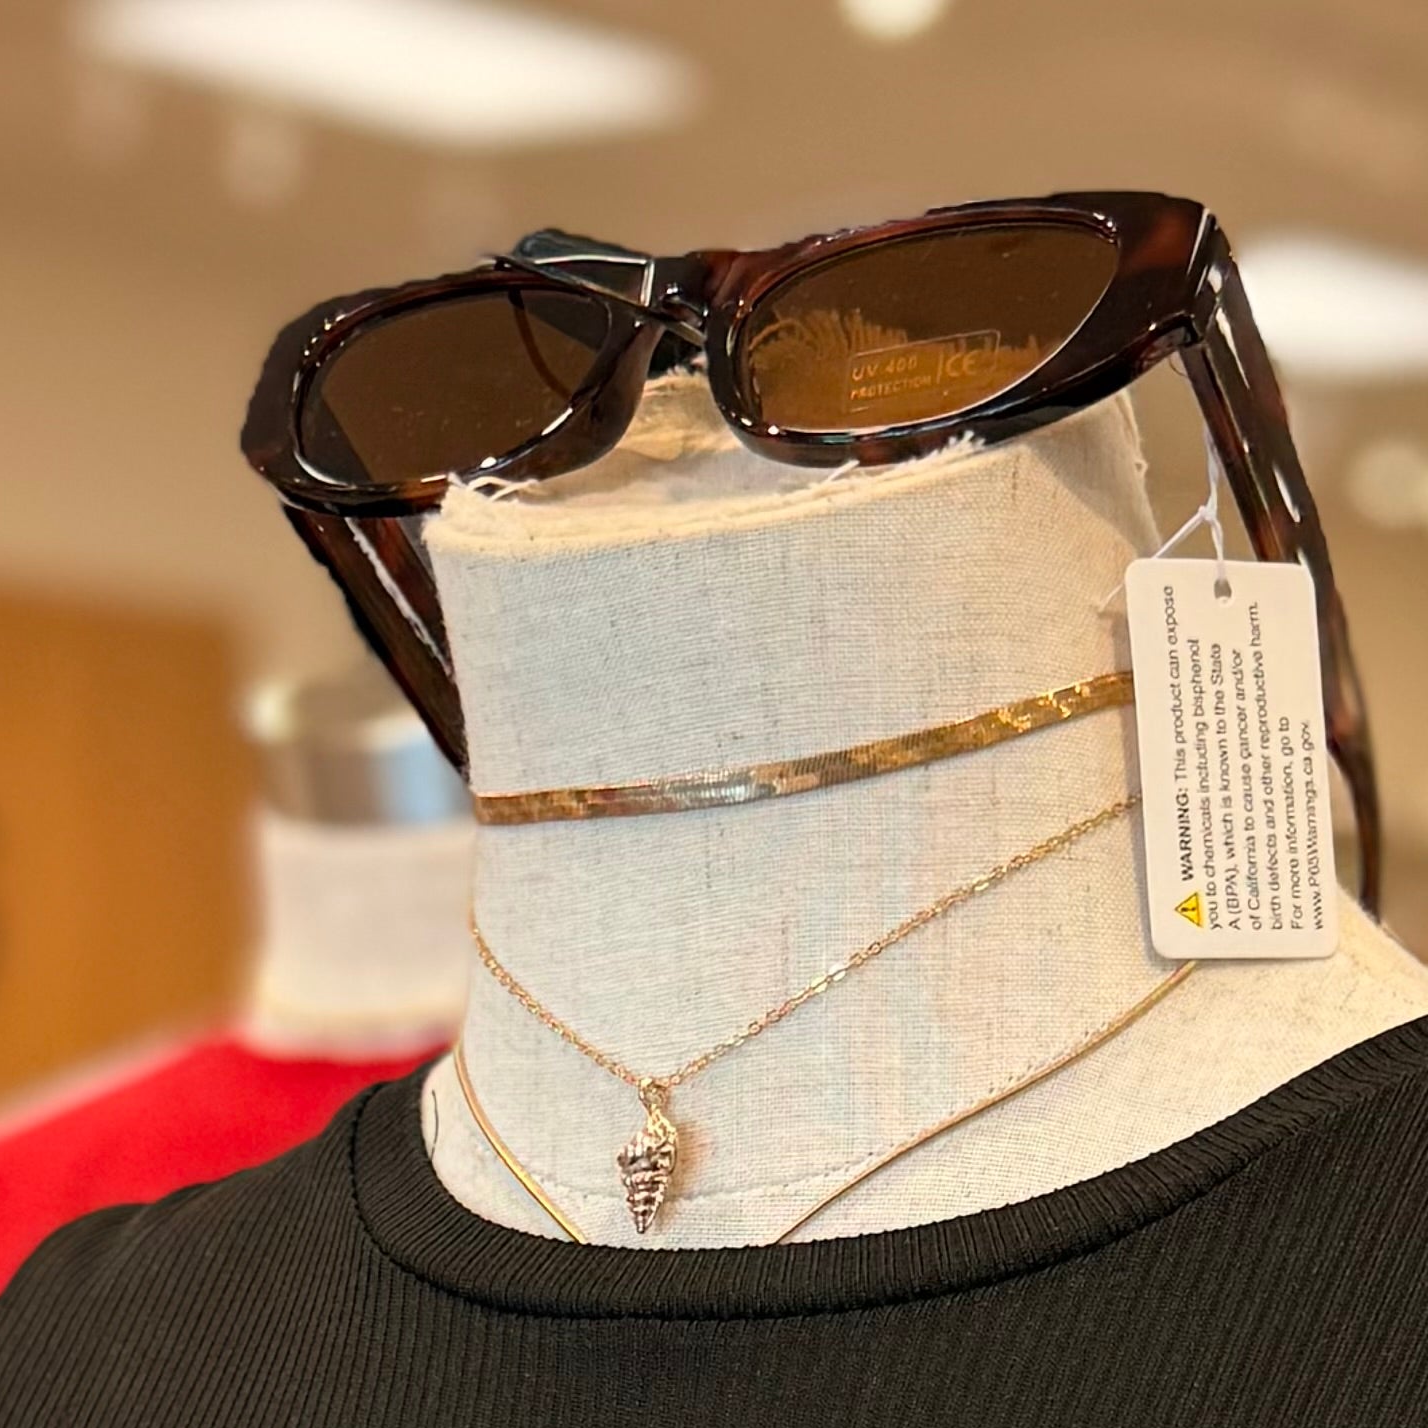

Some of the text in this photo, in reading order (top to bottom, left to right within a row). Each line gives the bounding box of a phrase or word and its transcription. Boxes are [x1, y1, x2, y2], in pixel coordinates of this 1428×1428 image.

[851, 355, 918, 382] UV 400
[945, 350, 978, 378] CE
[851, 375, 932, 400] PROTECTION
[1209, 642, 1224, 686] State
[1213, 689, 1226, 716] the
[1252, 650, 1271, 750] reproductive
[1163, 585, 1195, 882] WARNING: This product can expose
[1215, 718, 1227, 735] to
[1235, 704, 1253, 761] cancer
[1277, 716, 1290, 732] to
[1280, 735, 1295, 757] go
[1217, 738, 1231, 792] known
[1259, 753, 1274, 796] other
[1186, 638, 1224, 931] you to chemicals including bisphenol
[1240, 762, 1254, 813] cause
[1220, 794, 1233, 809] is
[1262, 798, 1277, 830] and
[1220, 812, 1236, 860] which
[1243, 815, 1256, 832] to
[1245, 835, 1261, 911] California
[1265, 832, 1281, 892] defects
[1288, 857, 1302, 900] more
[1227, 916, 1242, 931] A
[1248, 914, 1263, 931] of
[1269, 895, 1283, 930] birth
[1289, 903, 1304, 930] For
